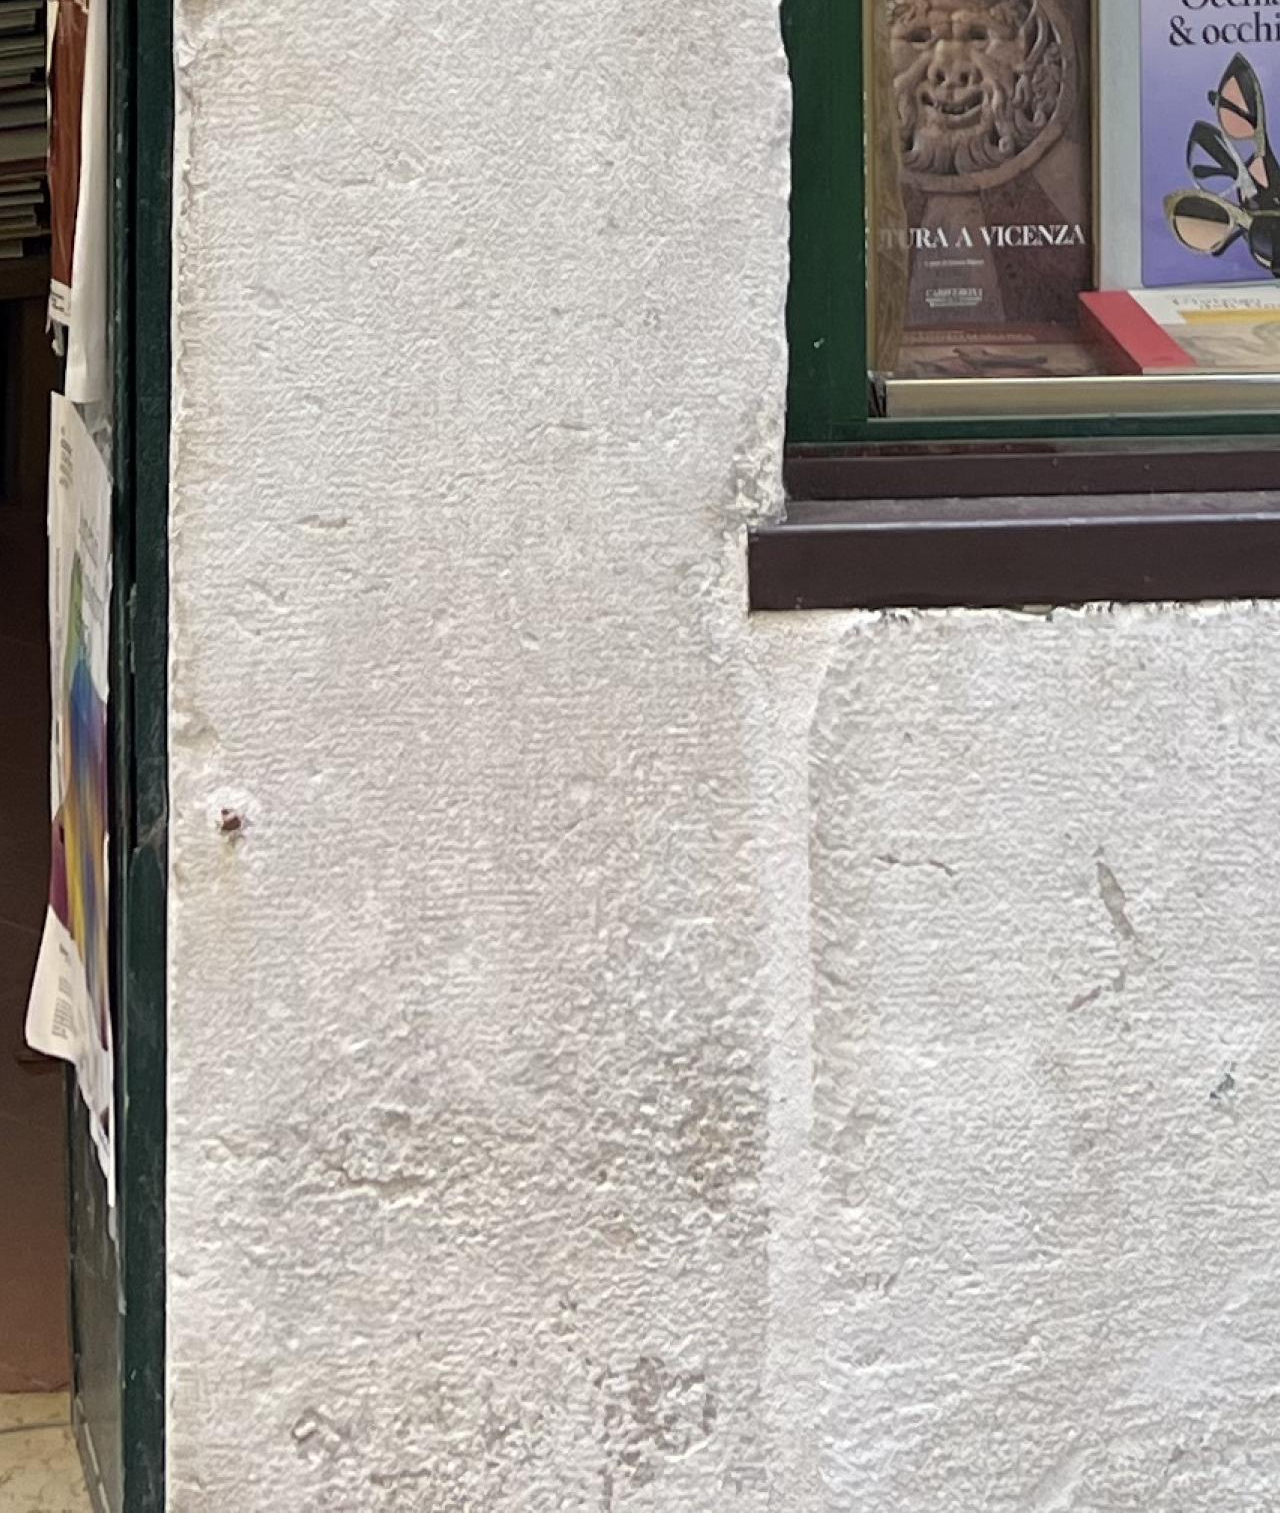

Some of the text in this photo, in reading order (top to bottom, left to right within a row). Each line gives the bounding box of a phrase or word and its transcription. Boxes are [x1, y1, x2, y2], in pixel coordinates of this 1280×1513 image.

[1169, 15, 1196, 46] &
[955, 224, 1086, 248] A VICENZA
